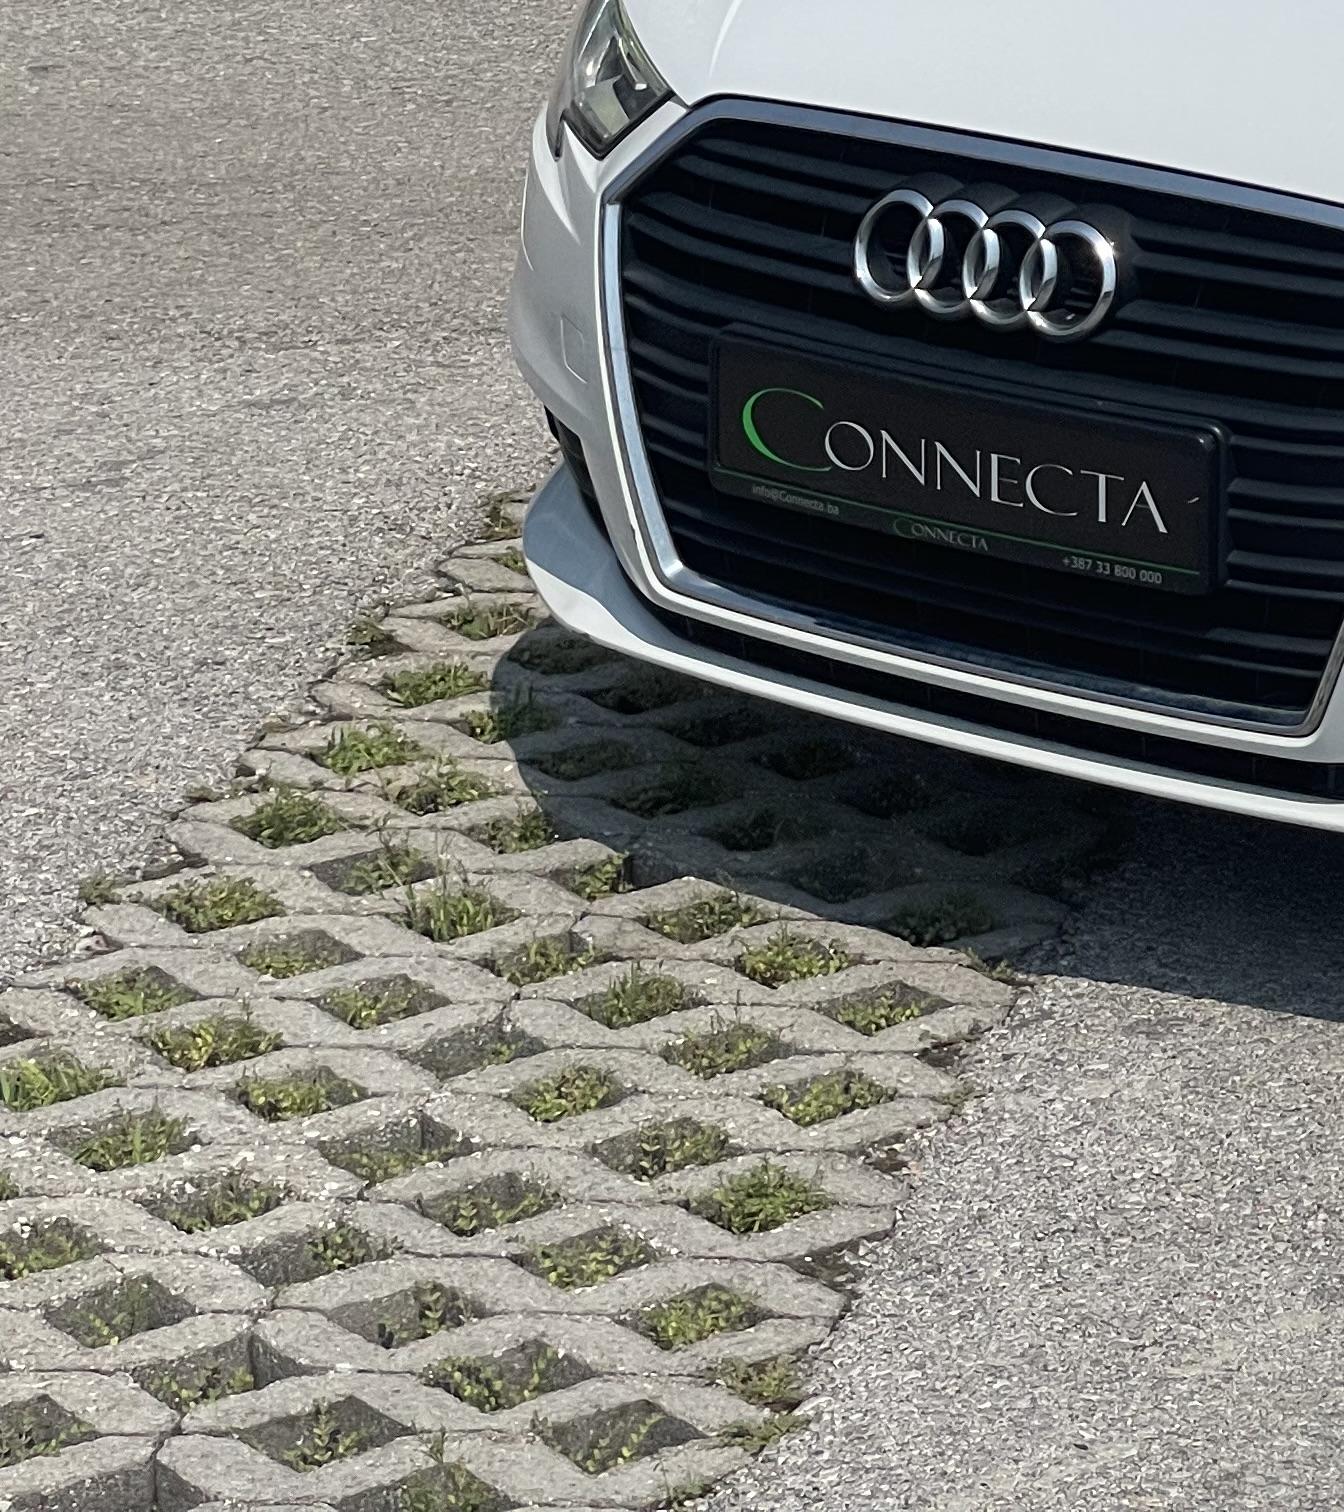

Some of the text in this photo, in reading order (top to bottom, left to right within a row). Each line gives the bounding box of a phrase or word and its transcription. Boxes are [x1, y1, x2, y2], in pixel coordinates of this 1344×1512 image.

[742, 388, 1168, 534] CONNECTA
[752, 485, 839, 515] info@Connectaba
[893, 518, 988, 551] CONNECTA
[1062, 556, 1092, 570] +387
[1096, 561, 1111, 575] 33
[1139, 569, 1162, 584] 000
